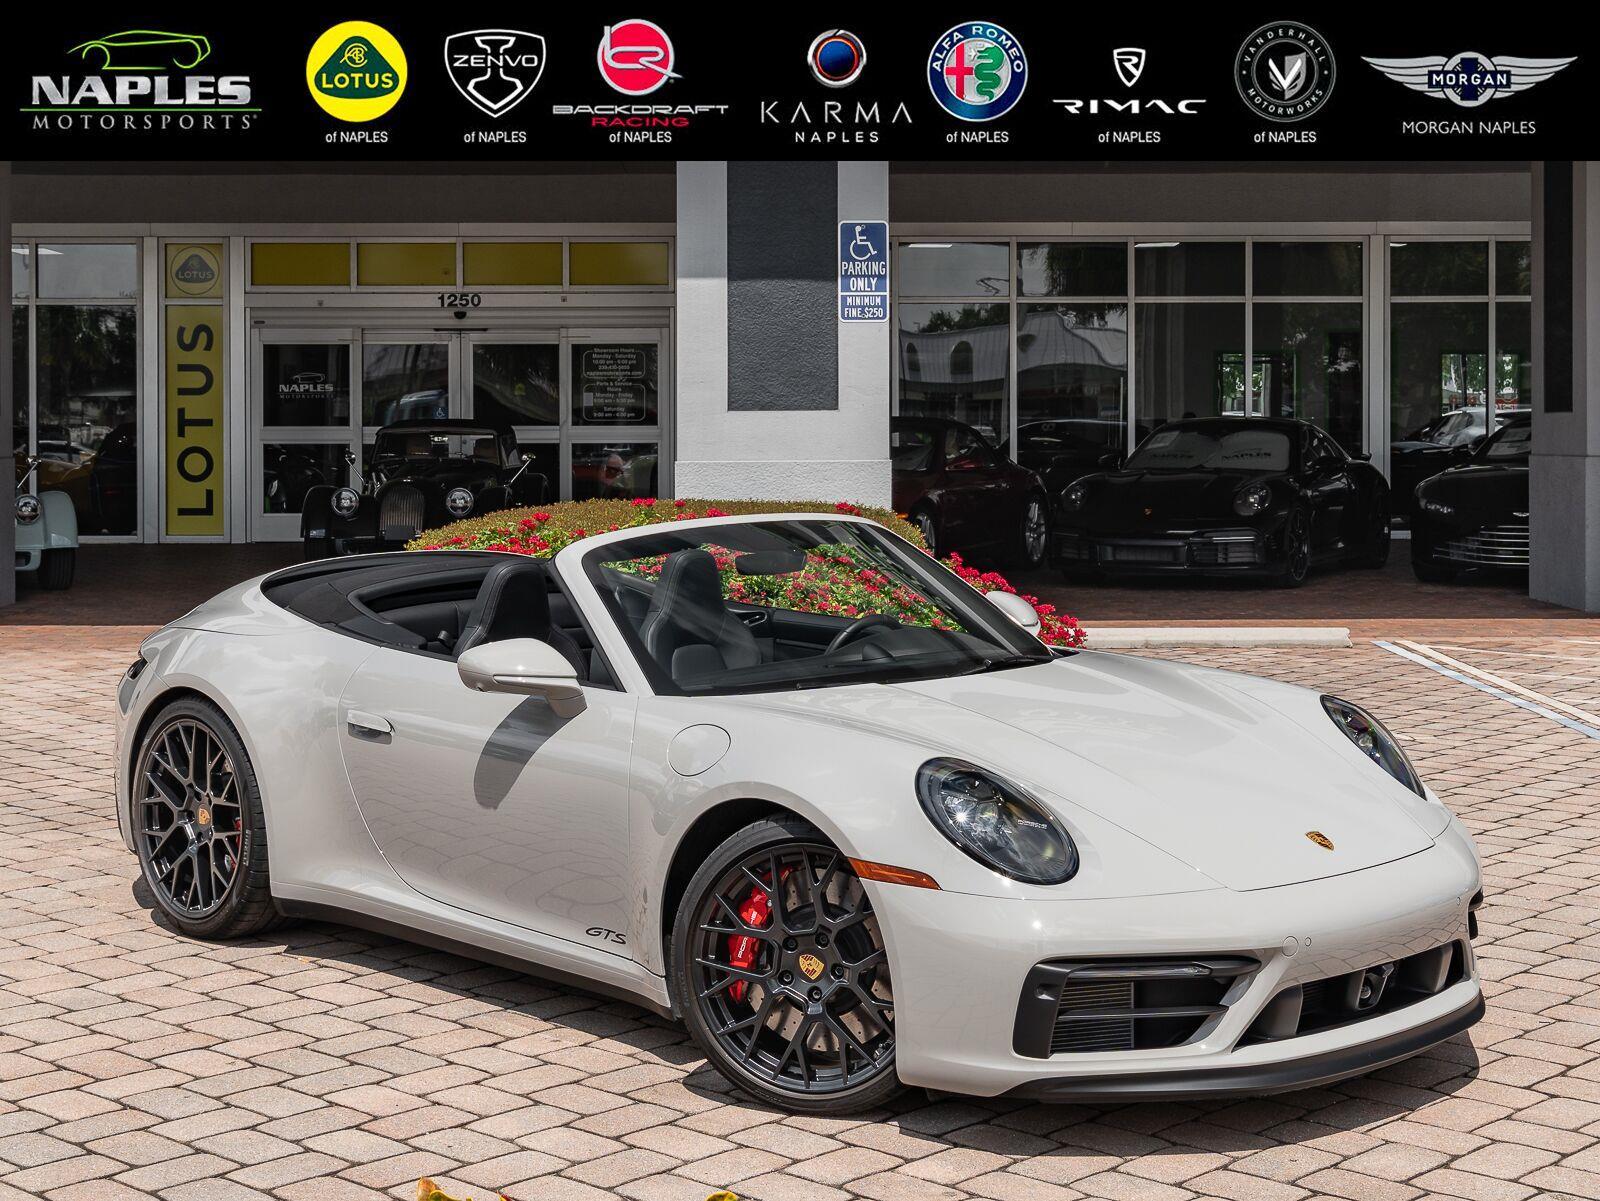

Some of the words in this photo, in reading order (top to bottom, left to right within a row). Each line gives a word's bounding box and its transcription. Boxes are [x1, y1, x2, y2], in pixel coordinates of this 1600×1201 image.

[178, 271, 213, 279] LOTUS
[841, 261, 886, 276] PARKING
[850, 277, 878, 291] ONLY
[438, 293, 482, 307] 1250
[846, 296, 881, 306] MINIMUM
[844, 307, 862, 318] FINE
[864, 306, 884, 319] $250
[279, 383, 334, 392] NAPLES
[177, 323, 214, 516] LOTUS
[585, 926, 626, 944] GTS
